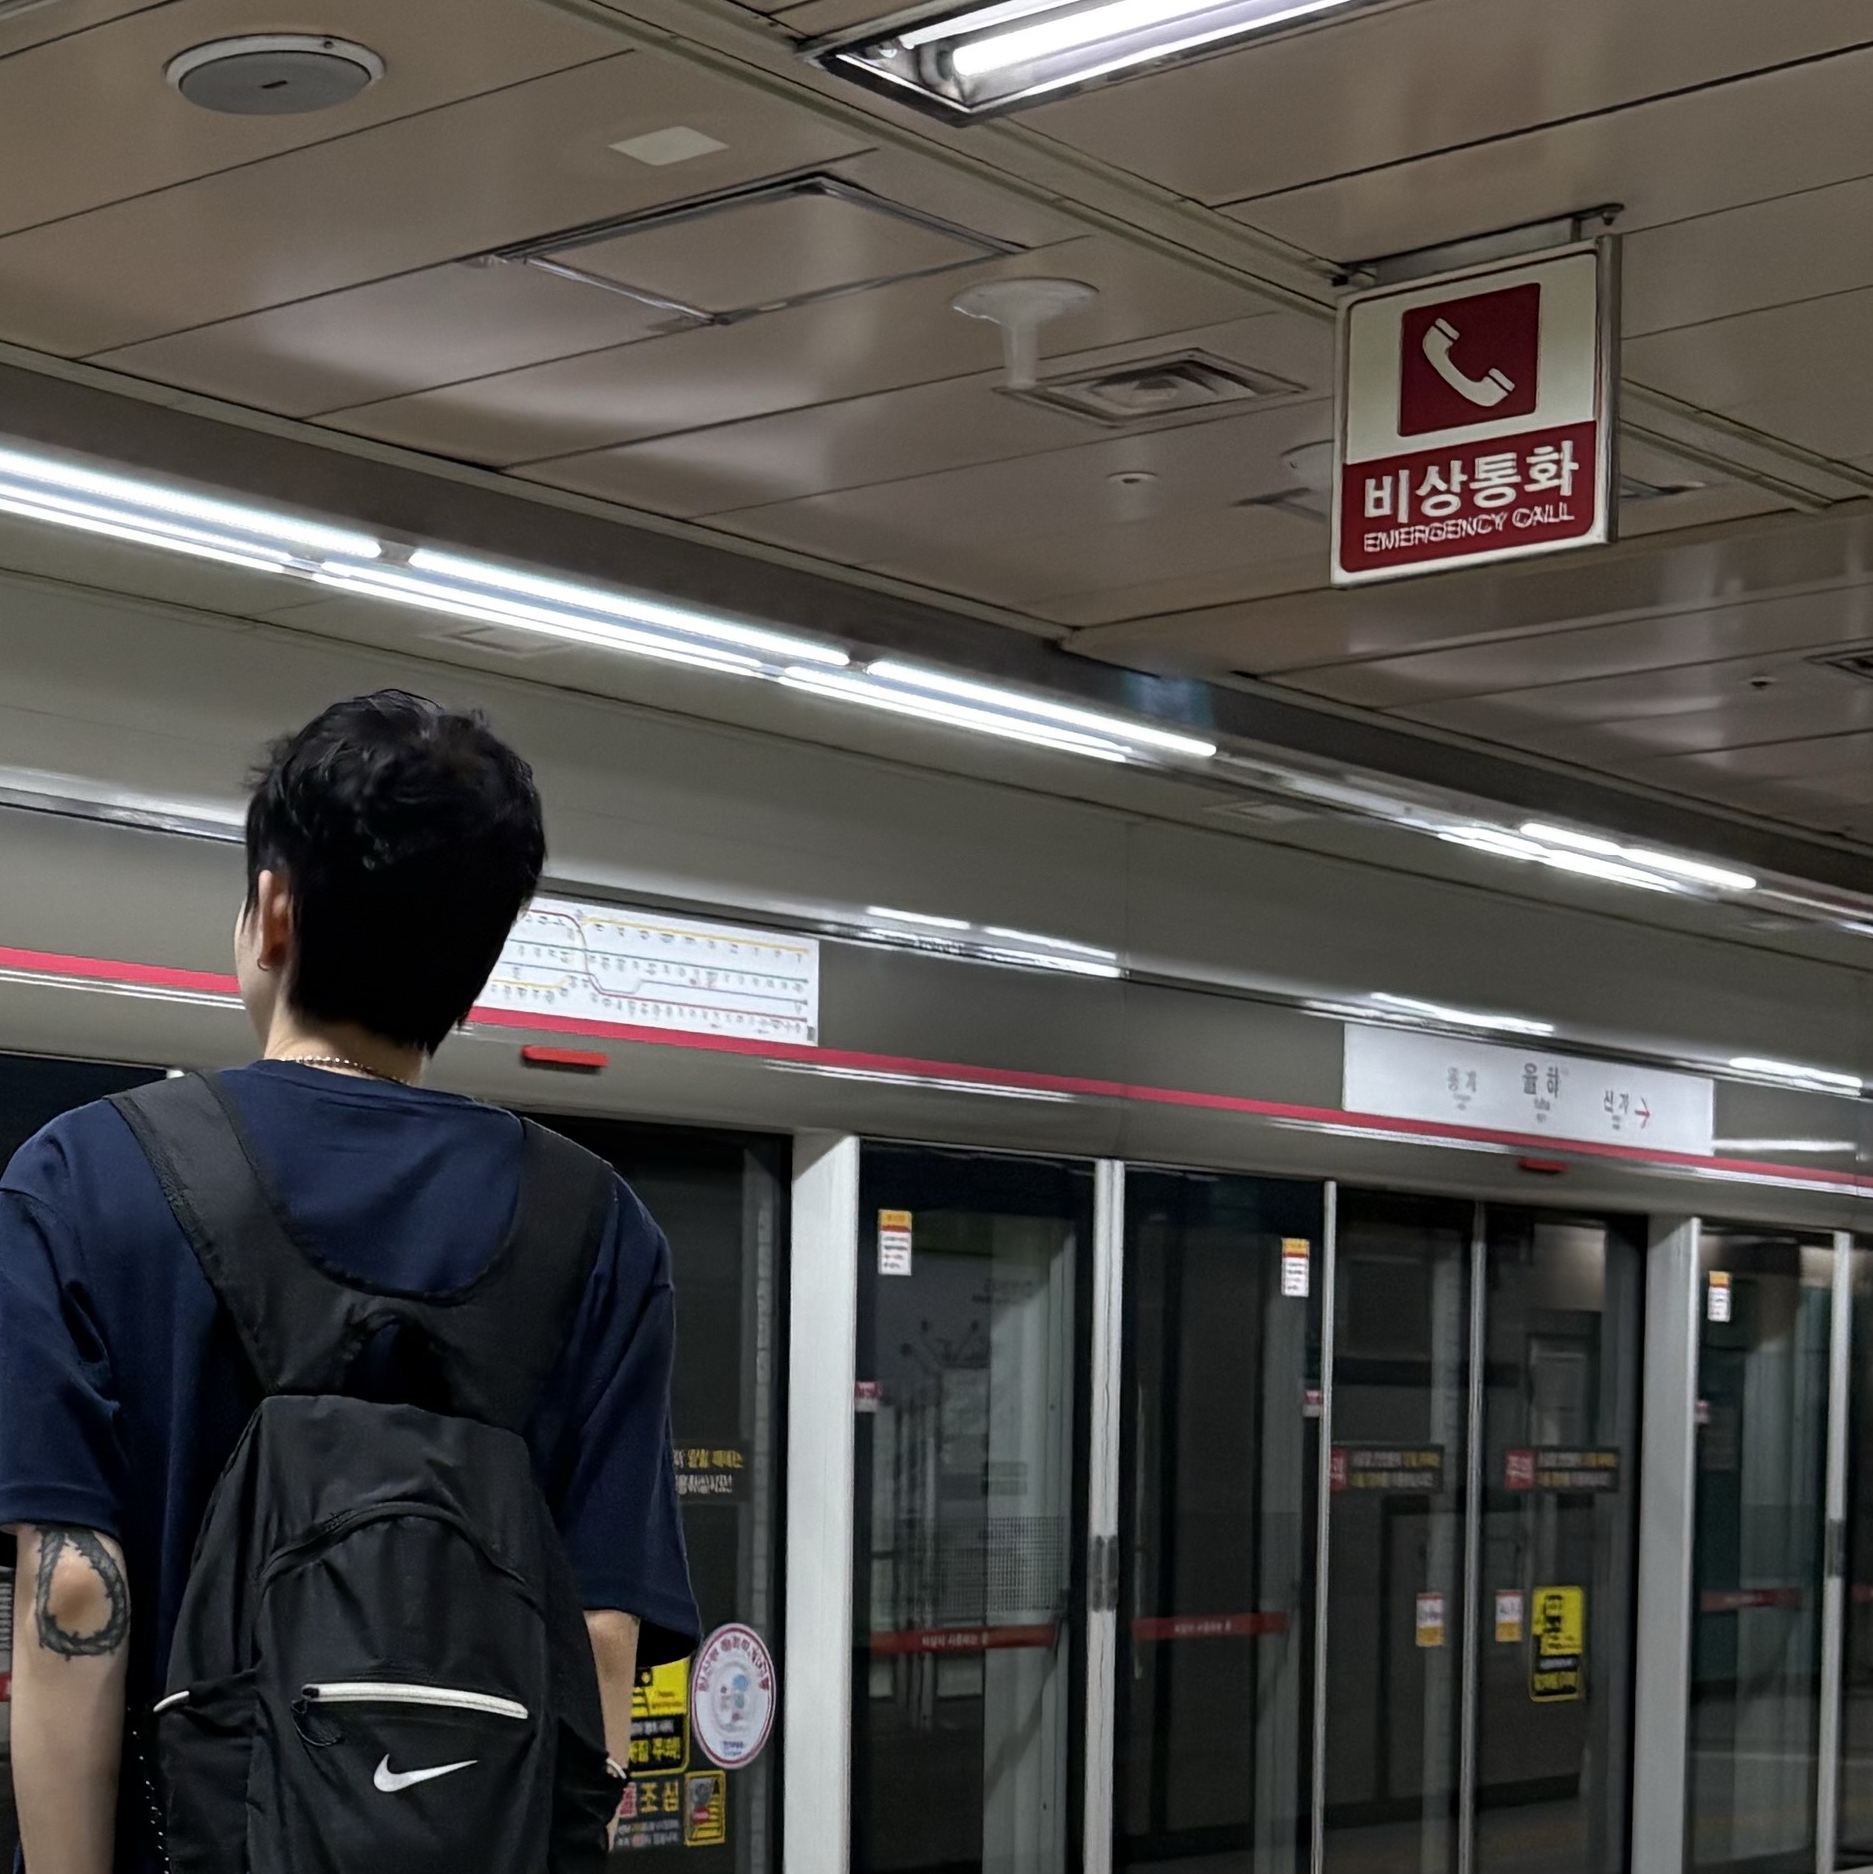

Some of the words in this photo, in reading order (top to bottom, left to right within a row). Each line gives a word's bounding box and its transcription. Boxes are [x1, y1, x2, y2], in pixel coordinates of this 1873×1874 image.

[1364, 439, 1580, 523] 비상통화
[1363, 509, 1506, 553] EMERGENCY
[1512, 501, 1575, 528] CALL
